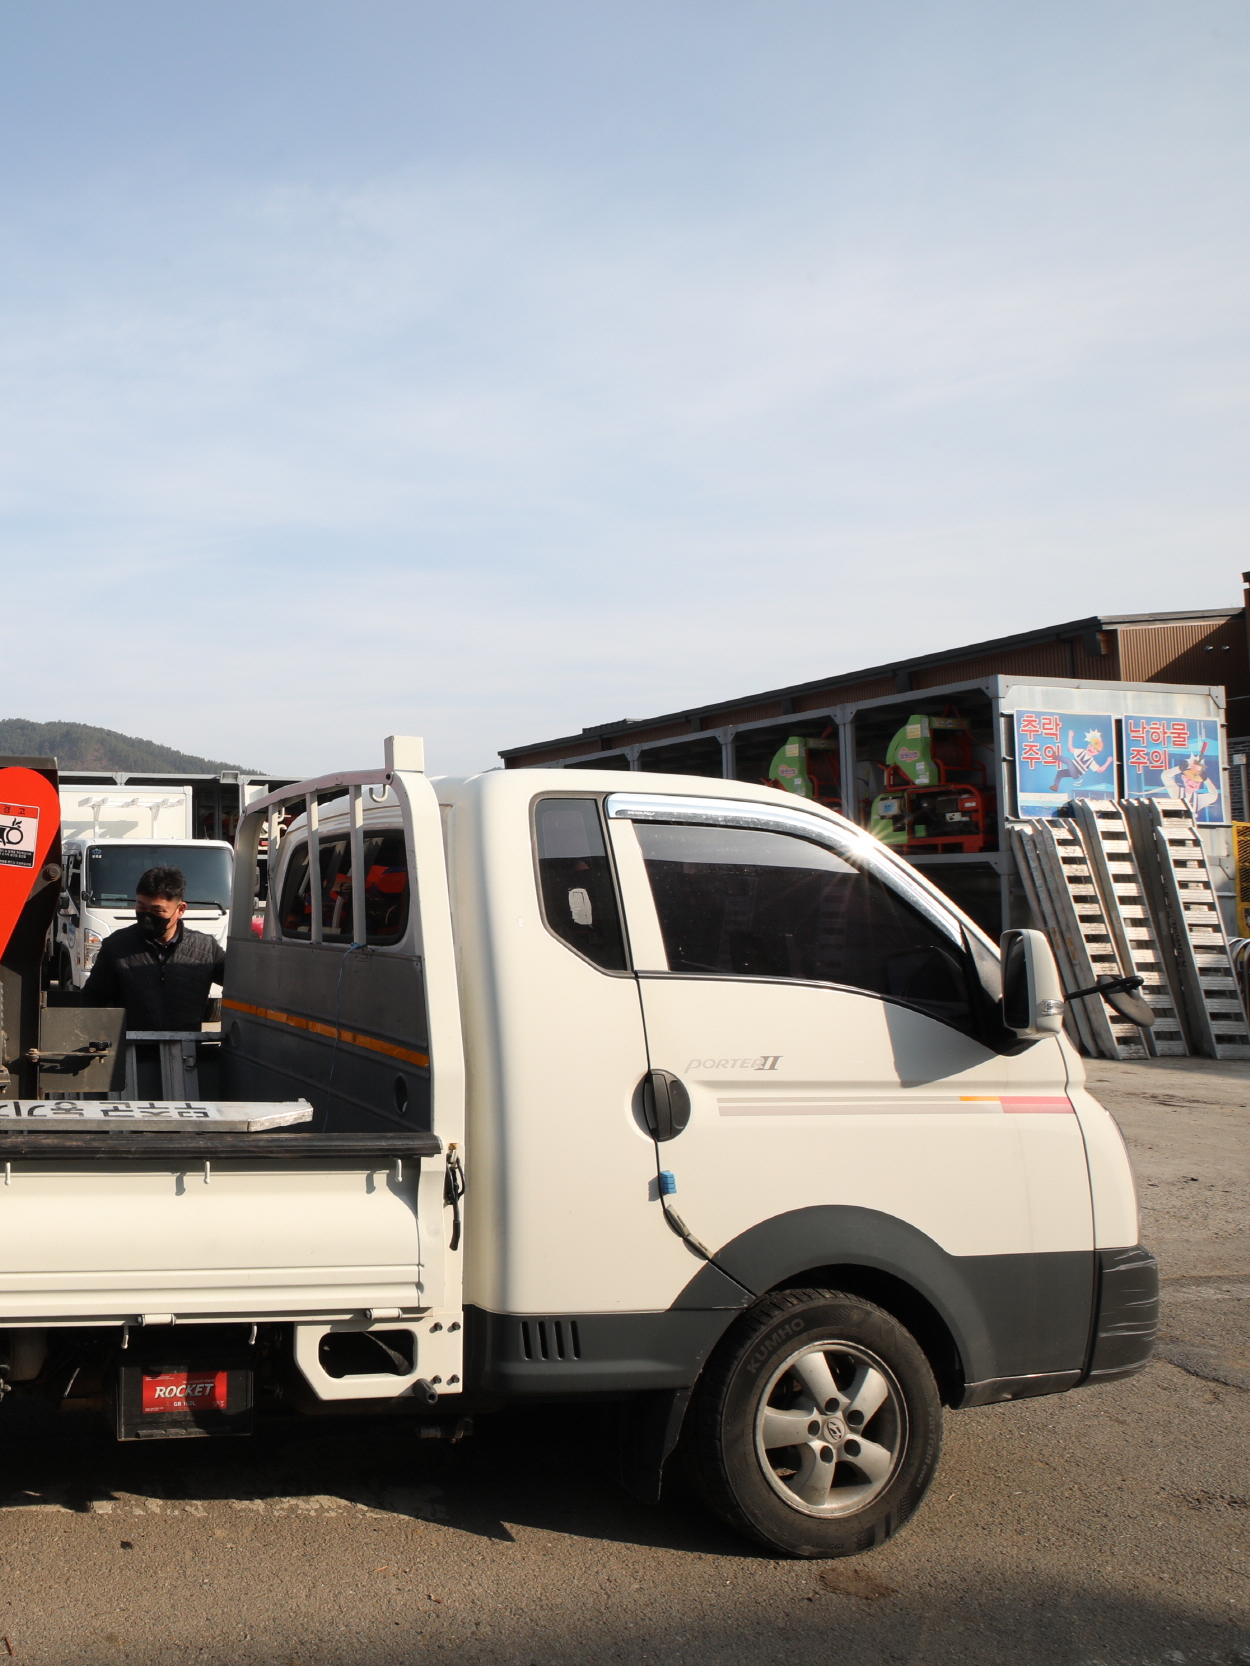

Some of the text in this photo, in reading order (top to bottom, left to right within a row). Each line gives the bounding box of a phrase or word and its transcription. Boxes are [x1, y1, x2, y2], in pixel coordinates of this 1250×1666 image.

[1020, 714, 1062, 741] 추락
[1128, 719, 1190, 748] 낙하물
[1021, 743, 1062, 770] 주의
[1129, 748, 1169, 773] 주의
[684, 1058, 765, 1074] PORTER
[99, 1100, 211, 1118] 무주군
[746, 1318, 805, 1374] KUMHO
[154, 1383, 215, 1399] ROCKET
